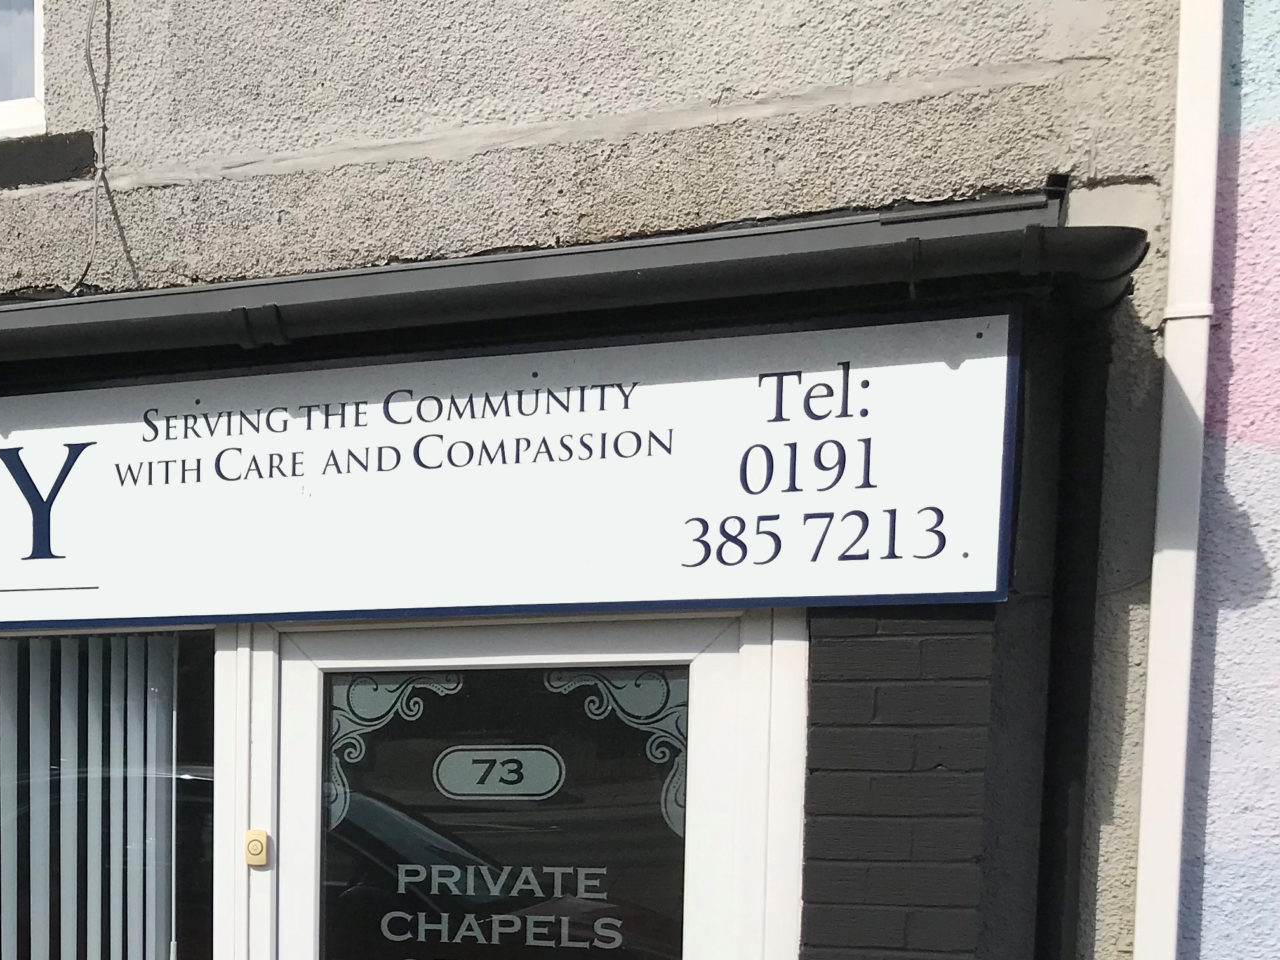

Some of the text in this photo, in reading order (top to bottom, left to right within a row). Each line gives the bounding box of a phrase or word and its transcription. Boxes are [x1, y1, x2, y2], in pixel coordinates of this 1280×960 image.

[141, 380, 641, 444] SERVING THE COMMUNITY
[758, 361, 872, 424] Tel:
[113, 427, 676, 489] WITH CARE AND COMPASSION
[738, 436, 879, 496] 0191
[681, 505, 948, 569] 385 7213
[471, 758, 525, 786] 73
[396, 863, 608, 900] PRIVATE
[380, 910, 624, 950] CHAPELS
